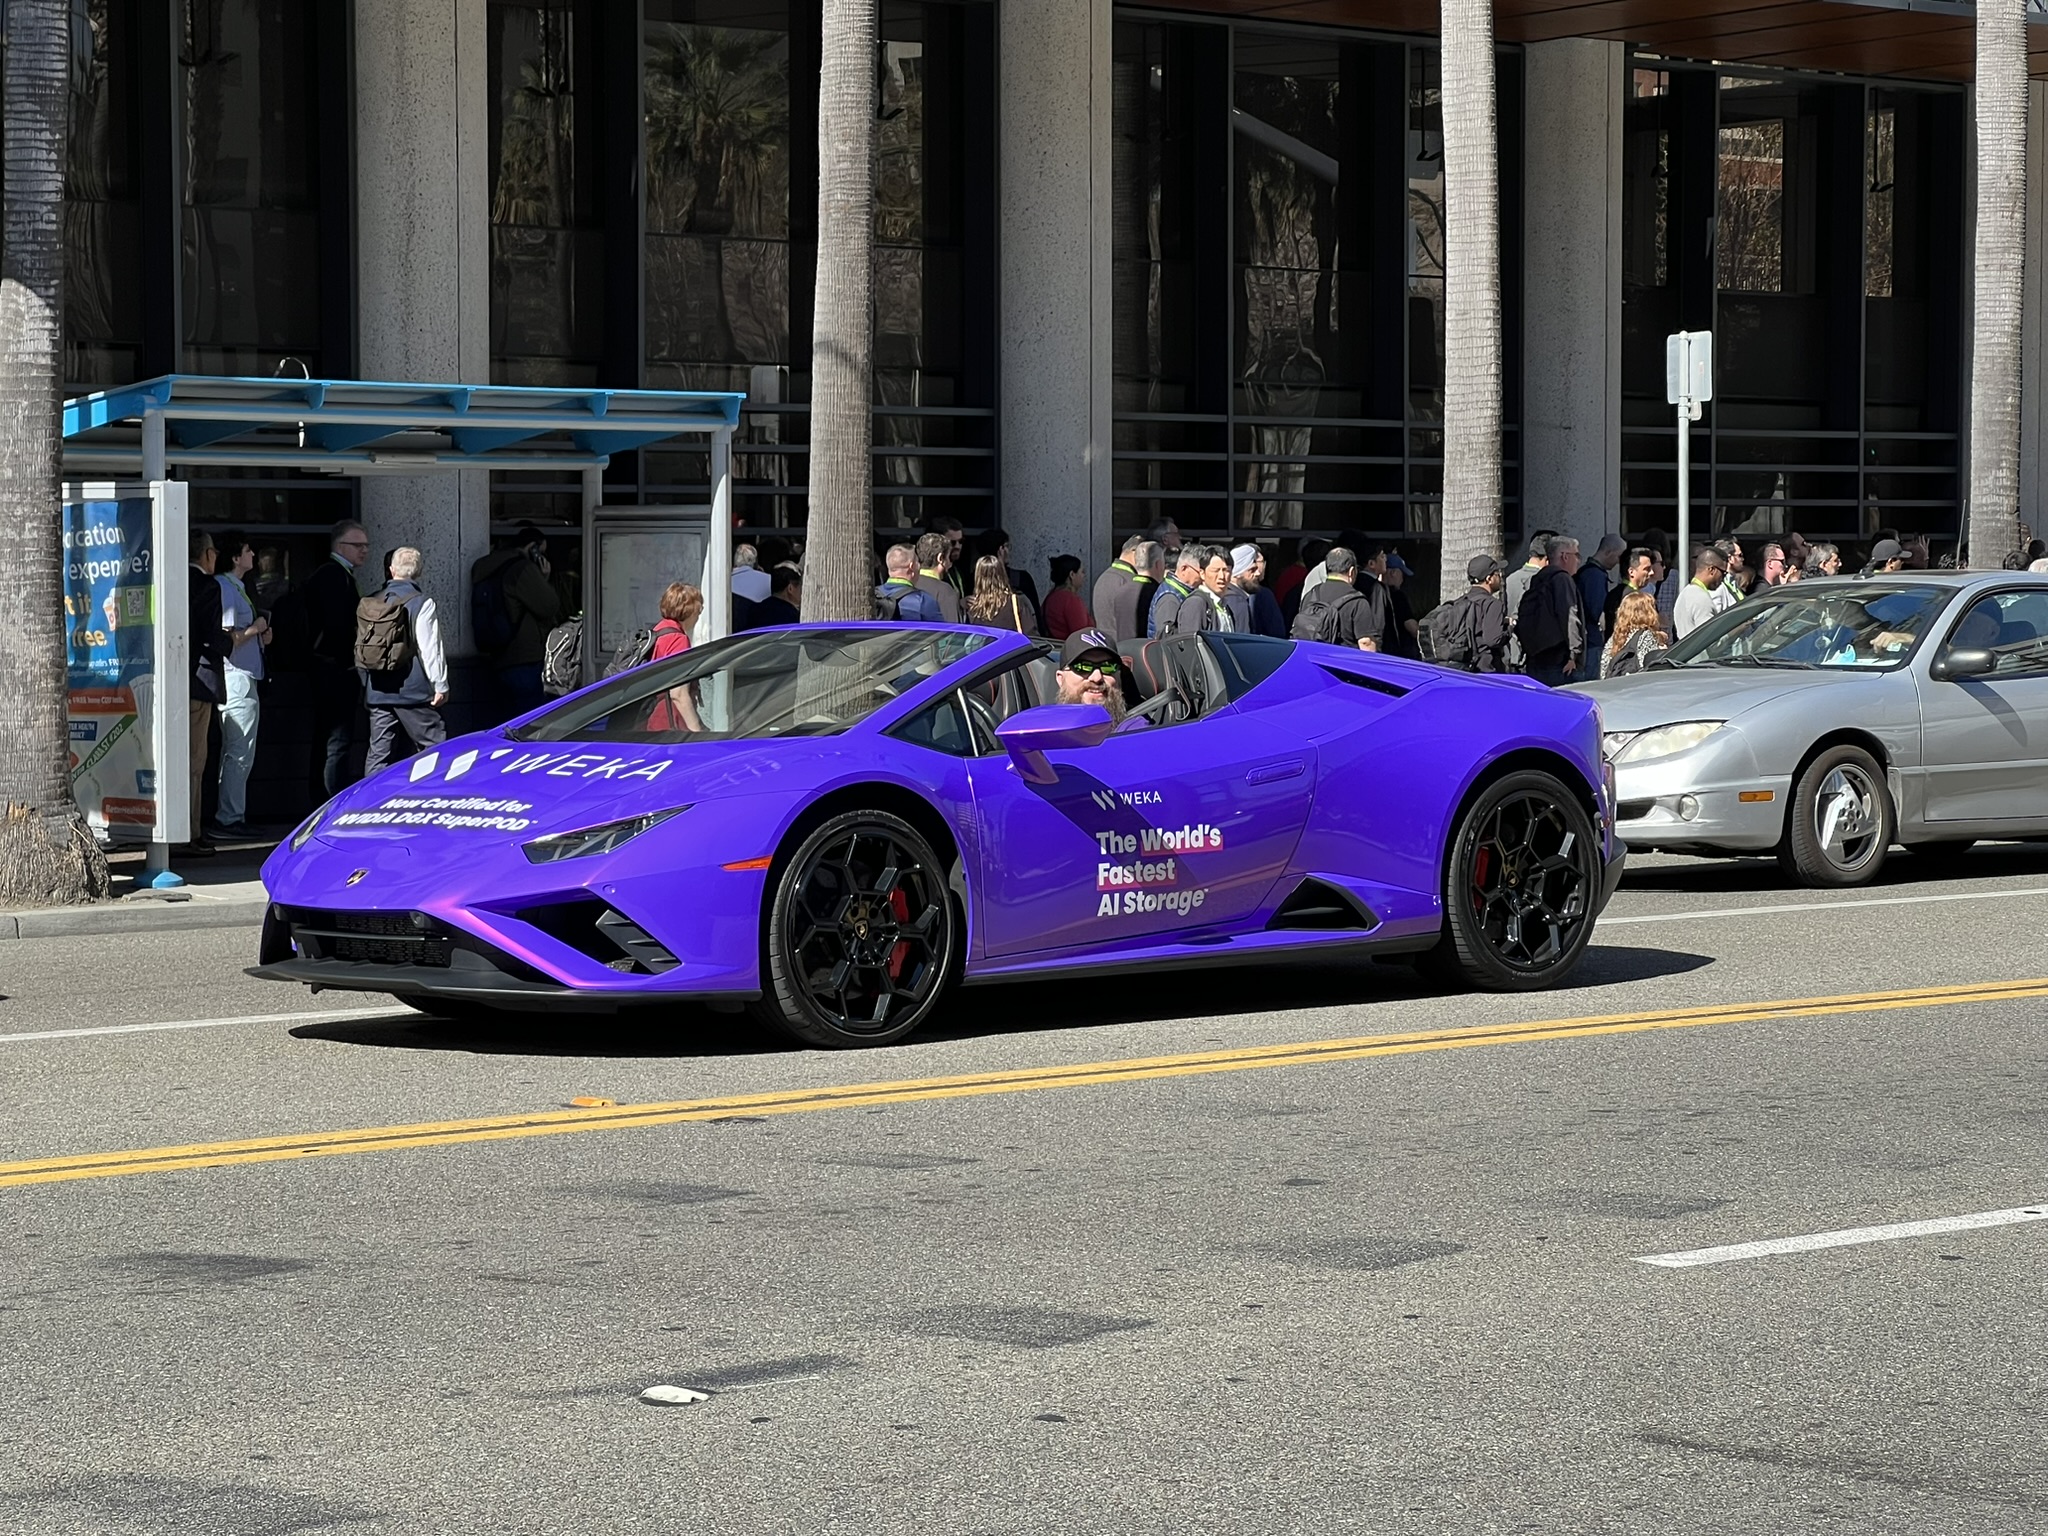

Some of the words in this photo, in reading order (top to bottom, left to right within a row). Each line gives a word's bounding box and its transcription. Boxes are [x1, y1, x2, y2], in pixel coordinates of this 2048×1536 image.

[501, 753, 673, 781] WEKA
[379, 798, 426, 809] Now
[421, 797, 507, 811] Certified
[497, 799, 533, 813] for
[1119, 790, 1163, 805] WEKA
[332, 812, 398, 825] NVIDIA
[391, 812, 440, 824] DGX
[1096, 830, 1137, 855] The
[1140, 824, 1221, 851] World's
[1098, 858, 1176, 886] Fastest
[1097, 893, 1119, 916] AI
